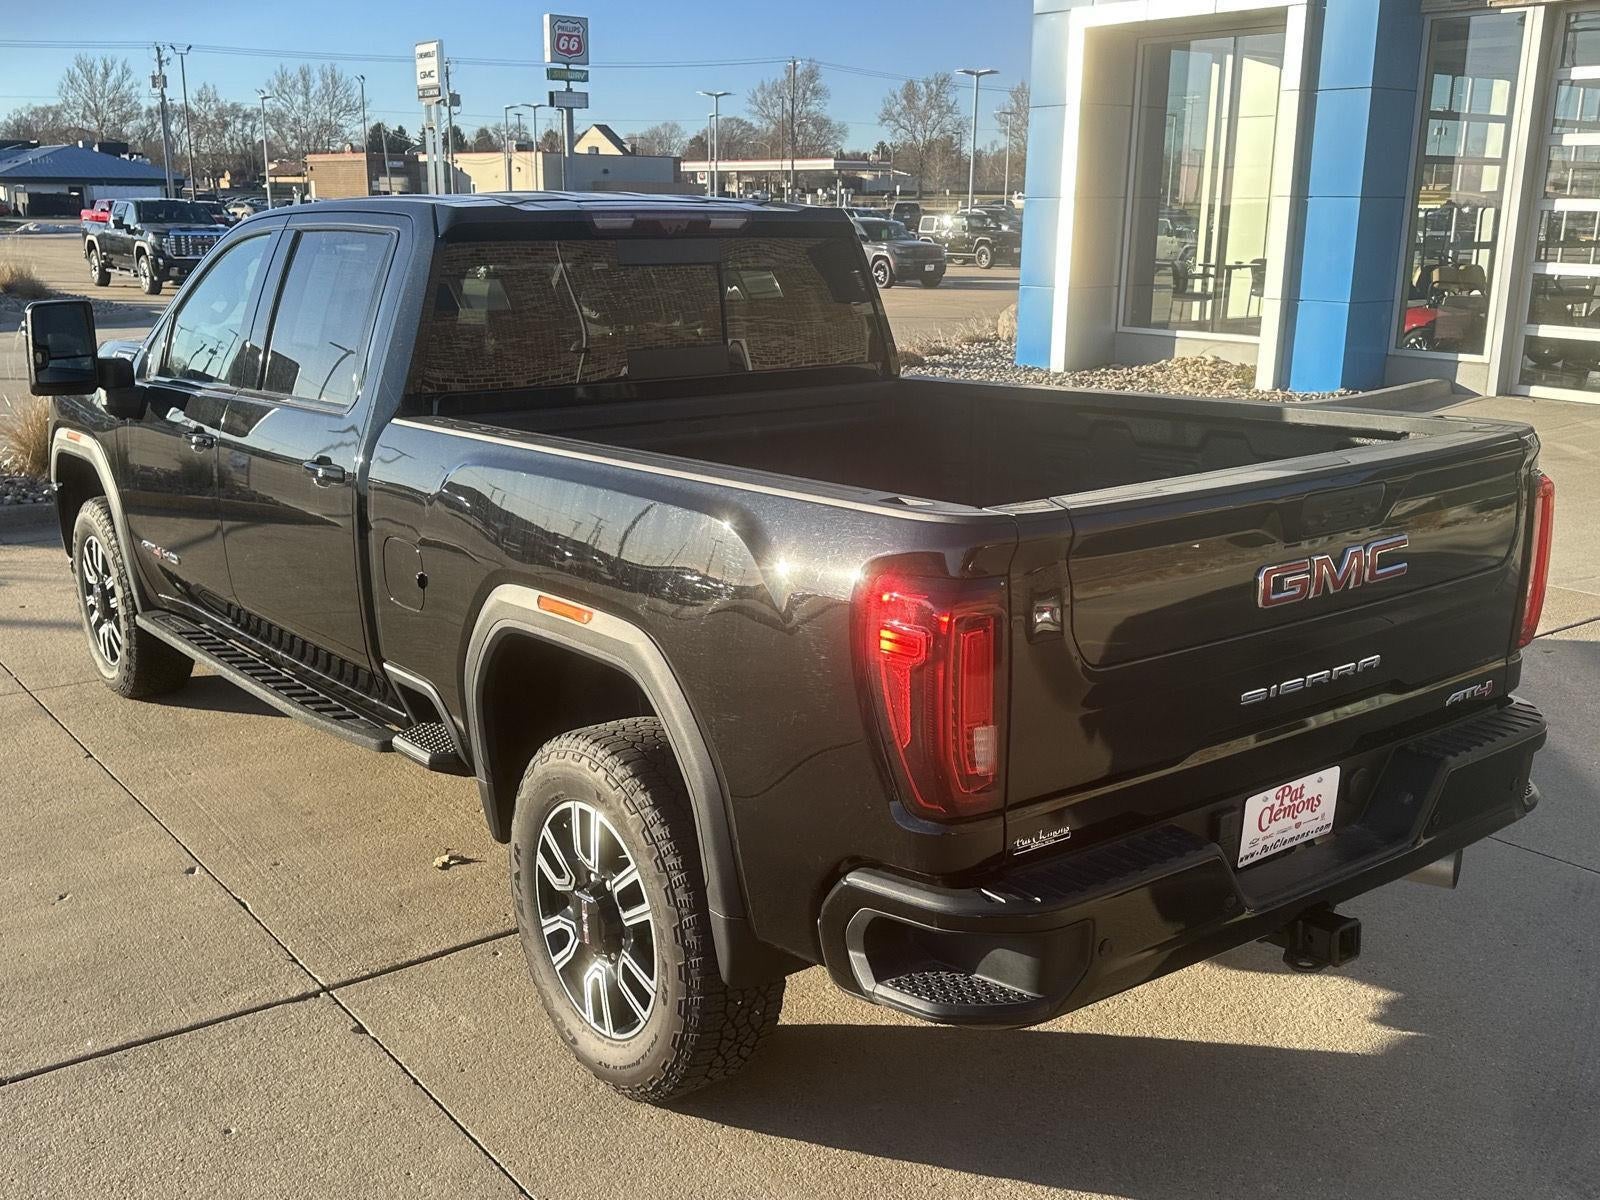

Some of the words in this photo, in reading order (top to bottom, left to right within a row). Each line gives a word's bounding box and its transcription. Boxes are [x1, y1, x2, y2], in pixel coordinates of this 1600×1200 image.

[557, 25, 581, 33] PHILLIPS
[559, 35, 579, 50] 66
[420, 70, 435, 79] GMC
[1257, 533, 1409, 609] GMC
[1240, 654, 1381, 706] SIERRA
[1445, 679, 1494, 707] AT4
[1275, 783, 1306, 807] Pat
[1258, 793, 1322, 833] Clemons
[1239, 822, 1332, 864] www.PatClemons.com
